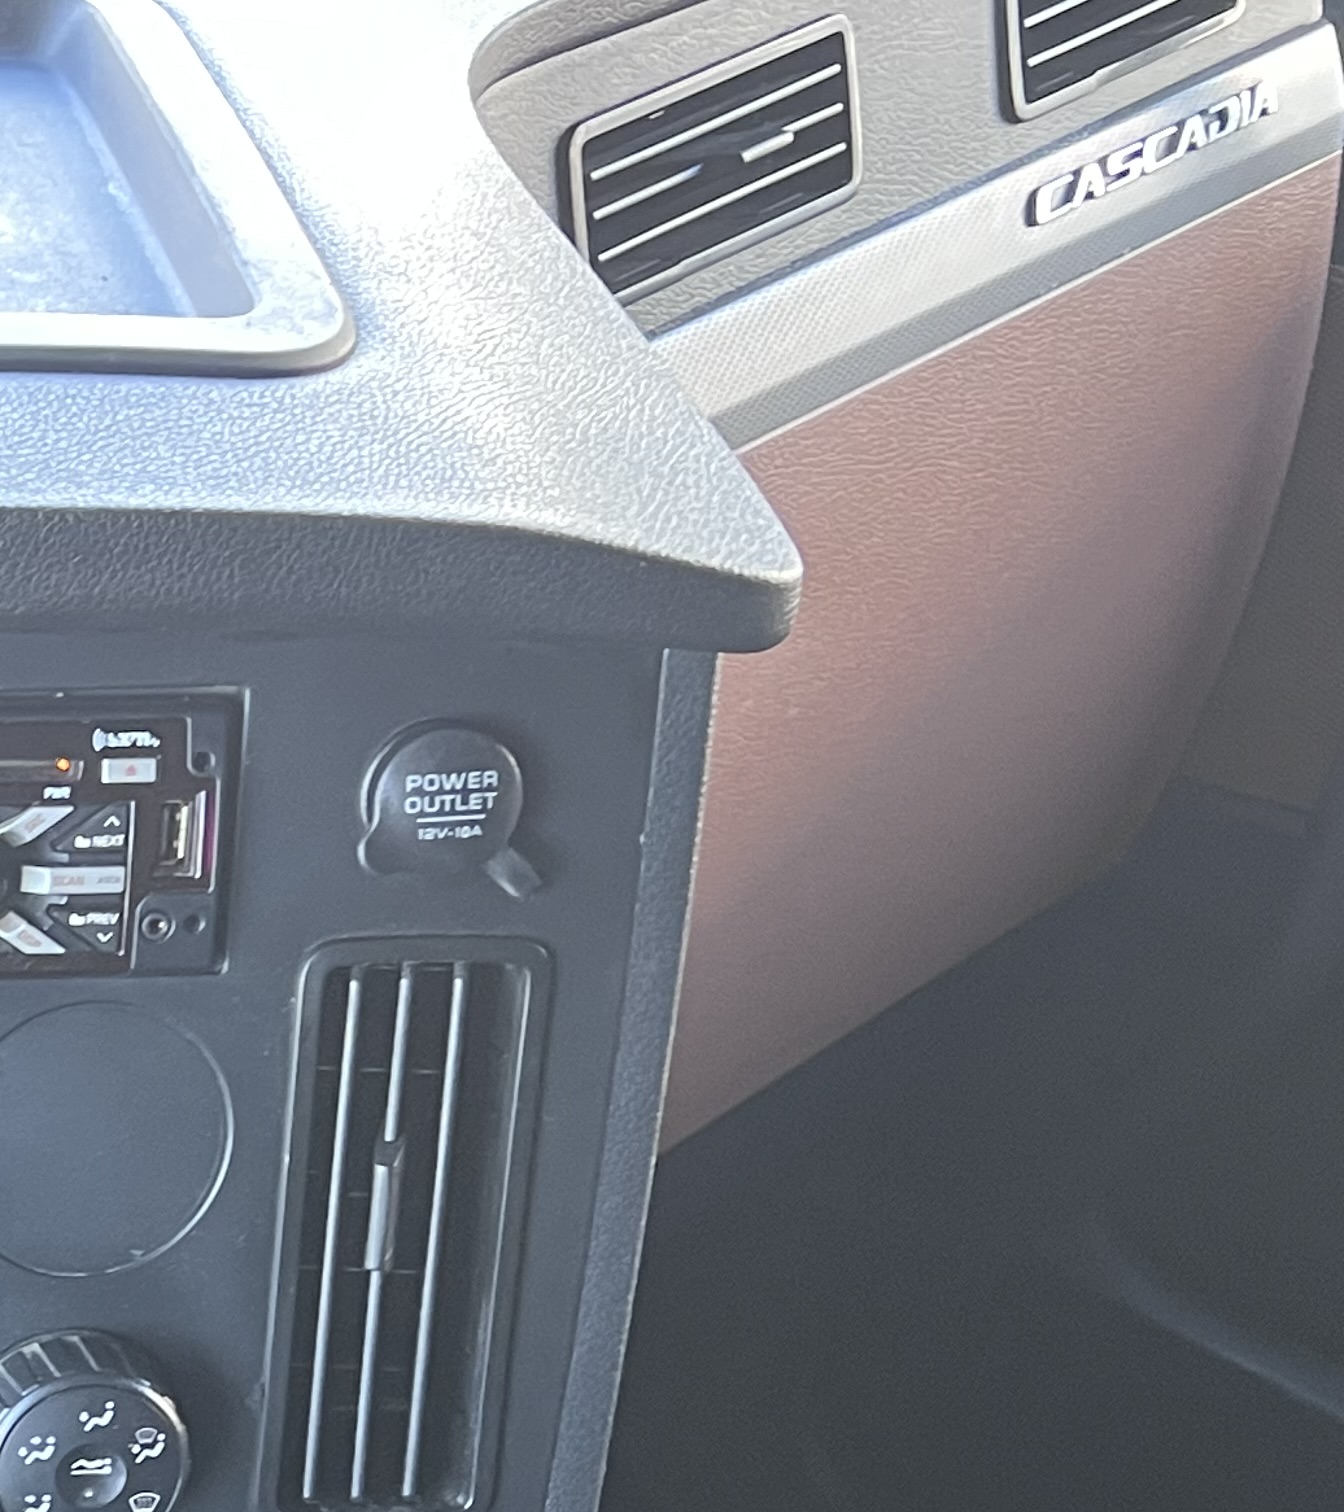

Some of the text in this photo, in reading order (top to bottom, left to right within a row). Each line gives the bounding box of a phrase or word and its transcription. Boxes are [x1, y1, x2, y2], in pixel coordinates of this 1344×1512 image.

[1026, 80, 1279, 227] CASCADIA
[404, 770, 499, 793] POWER
[403, 791, 499, 814] OUTLET
